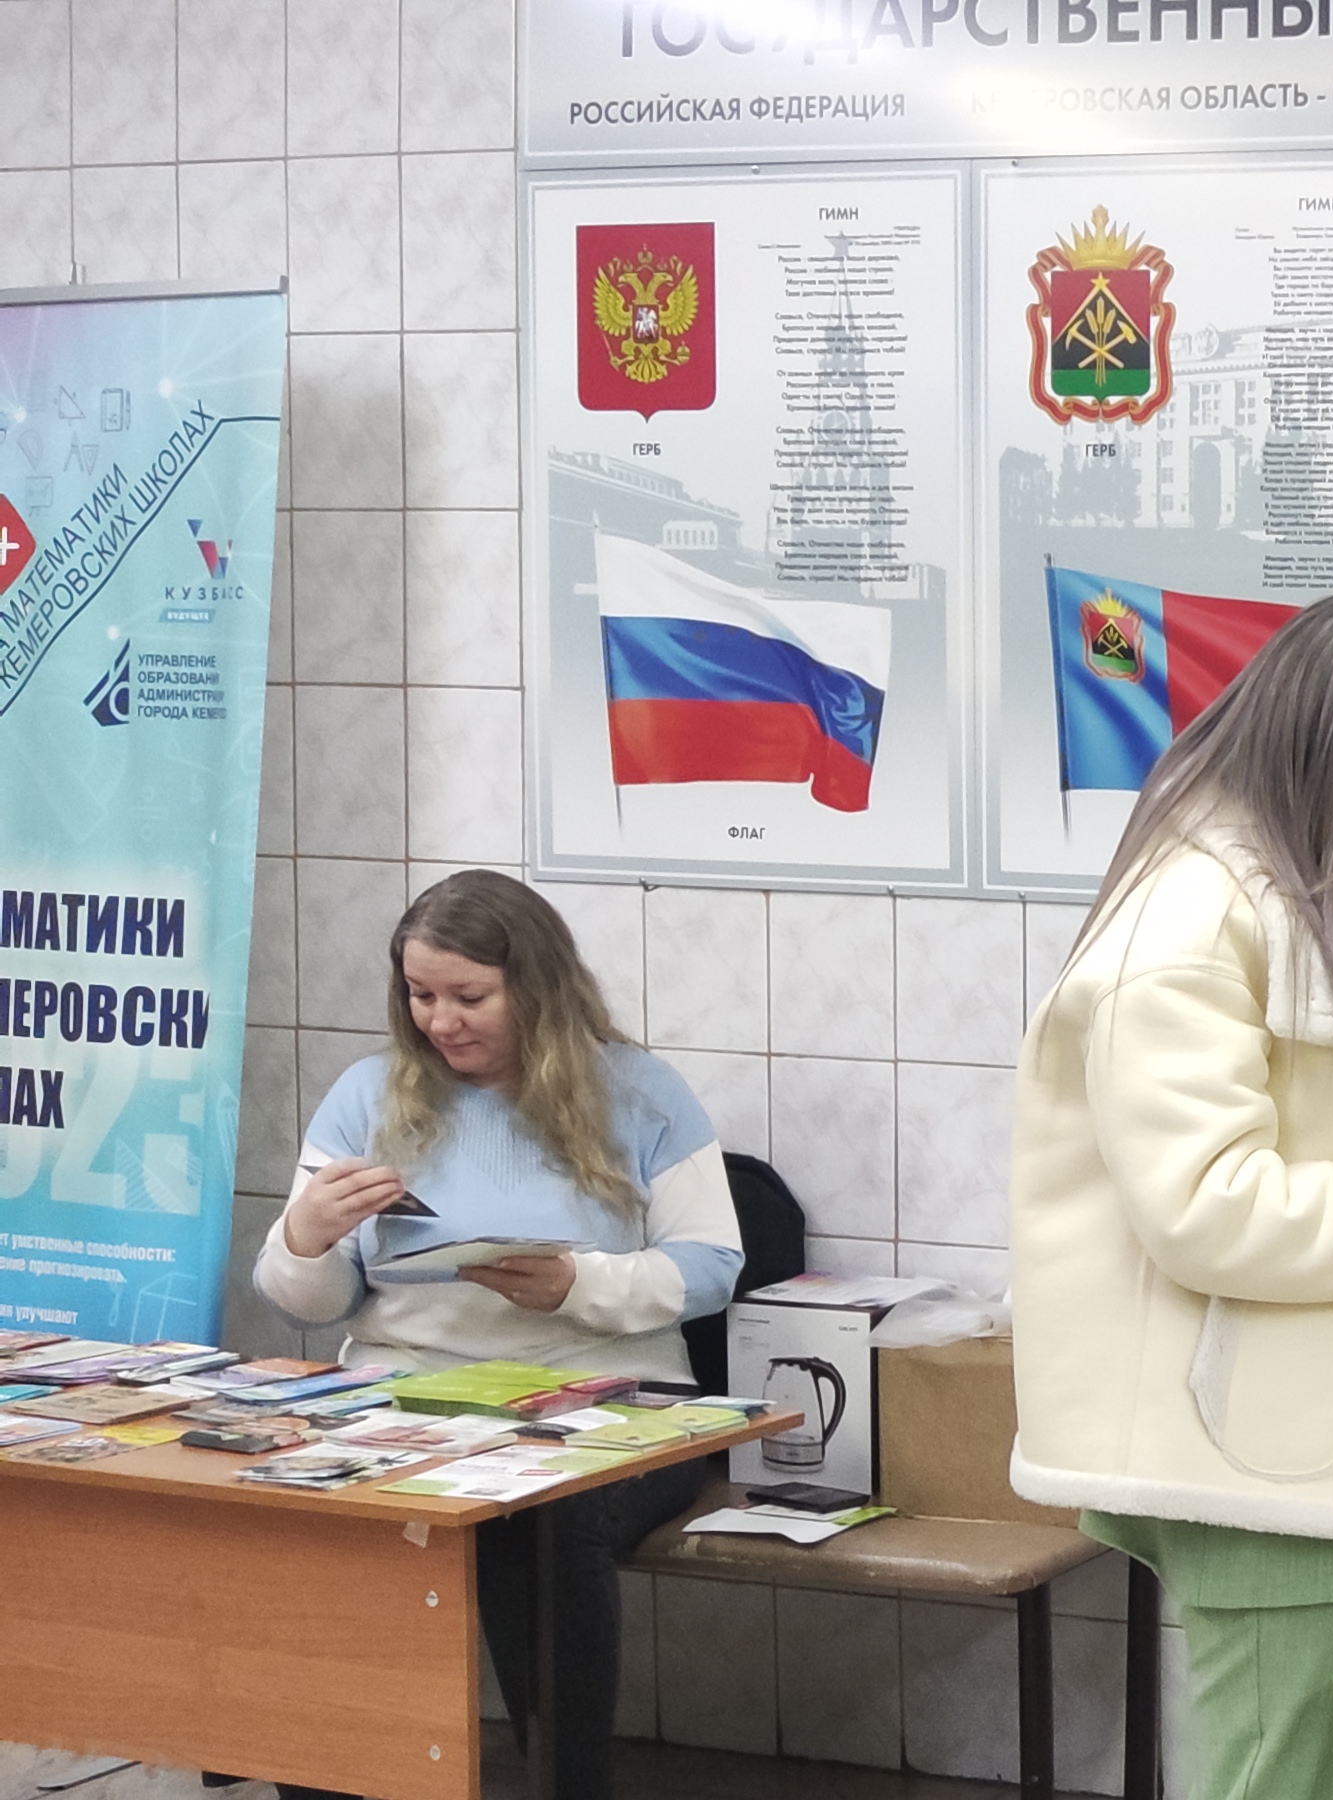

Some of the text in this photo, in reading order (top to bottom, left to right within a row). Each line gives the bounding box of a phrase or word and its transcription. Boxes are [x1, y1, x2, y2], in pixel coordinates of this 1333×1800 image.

[1180, 83, 1308, 110] ОБЛАСТЬ
[570, 93, 906, 125] РОССИЙСКАЯ ФЕДЕРАЦИЯ
[818, 207, 859, 221] ГИМН
[632, 441, 662, 457] ГЕРБ
[1084, 442, 1117, 458] ГЕРБ
[0, 398, 215, 690] КЕМЕРОВСКИХ ШКОЛАХ
[138, 654, 217, 668] УПРАВЛЕНИЕ
[138, 705, 189, 720] ГОРОДА
[727, 825, 766, 841] ФЛАГ
